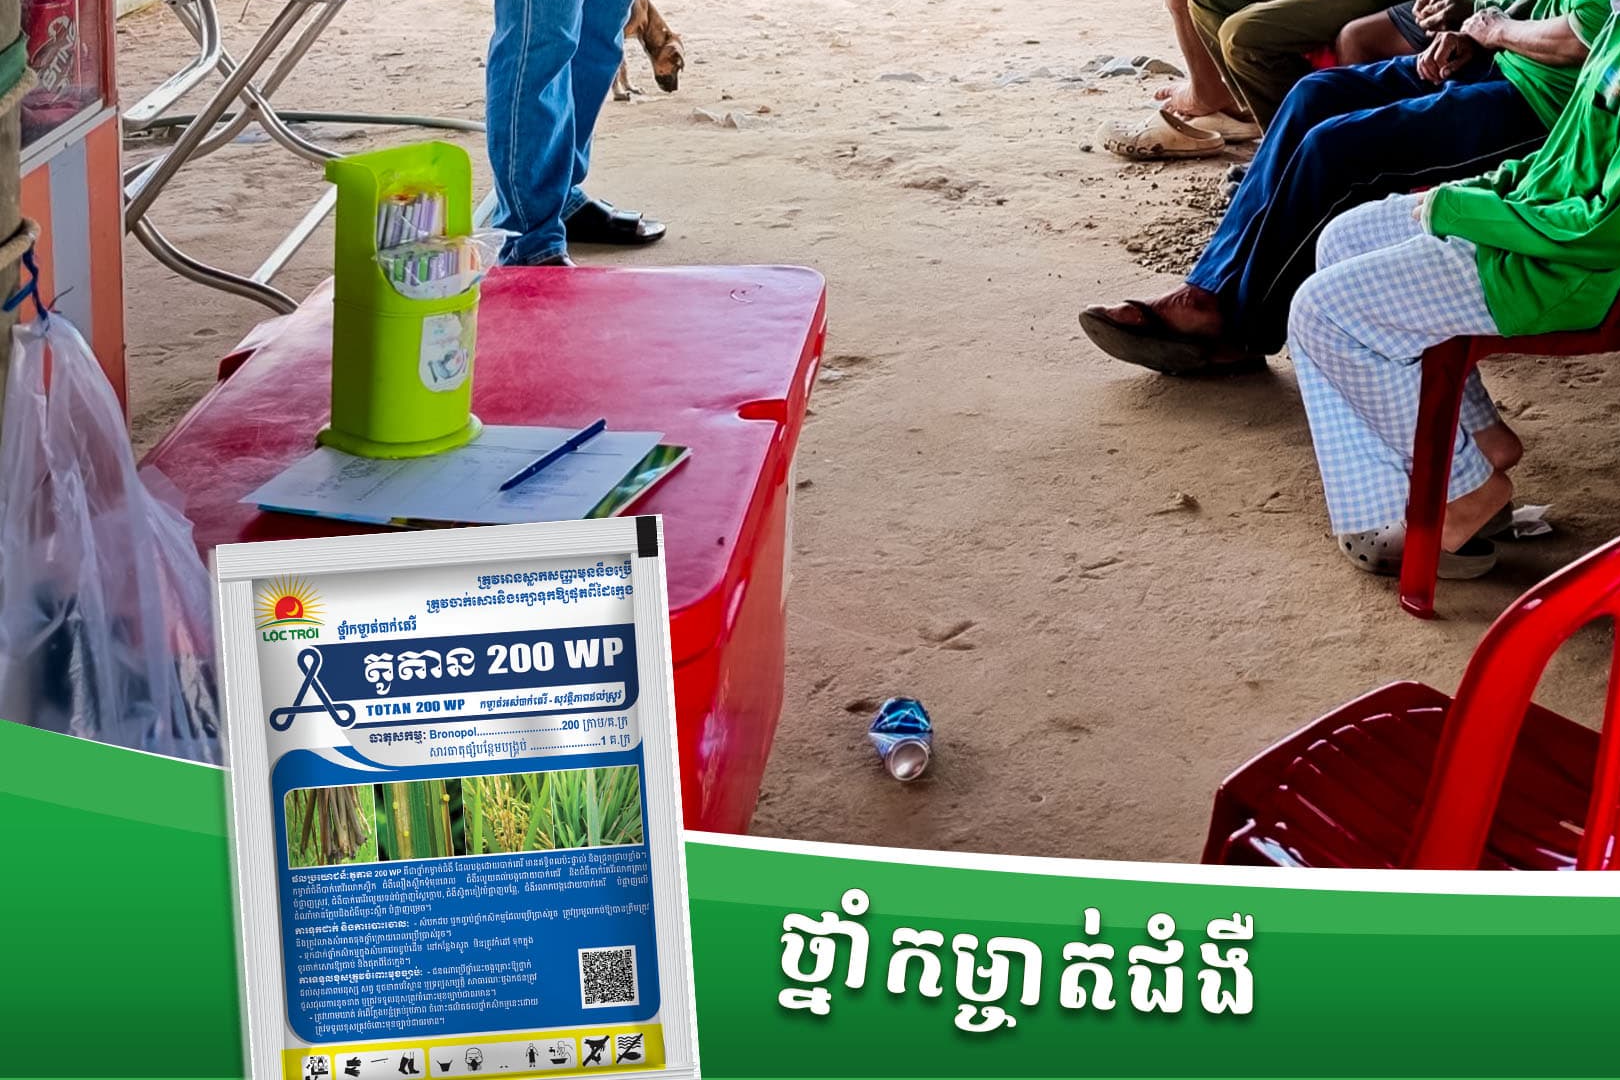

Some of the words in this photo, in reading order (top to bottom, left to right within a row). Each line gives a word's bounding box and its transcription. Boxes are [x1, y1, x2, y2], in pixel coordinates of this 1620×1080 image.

[262, 629, 288, 643] LỘC
[363, 647, 475, 696] តូតាន
[486, 641, 555, 675] 200
[563, 637, 623, 669] WP
[365, 702, 412, 717] TOTAN
[415, 700, 441, 713] 200
[443, 698, 465, 711] WP
[374, 869, 388, 881] 200
[388, 868, 403, 881] WP
